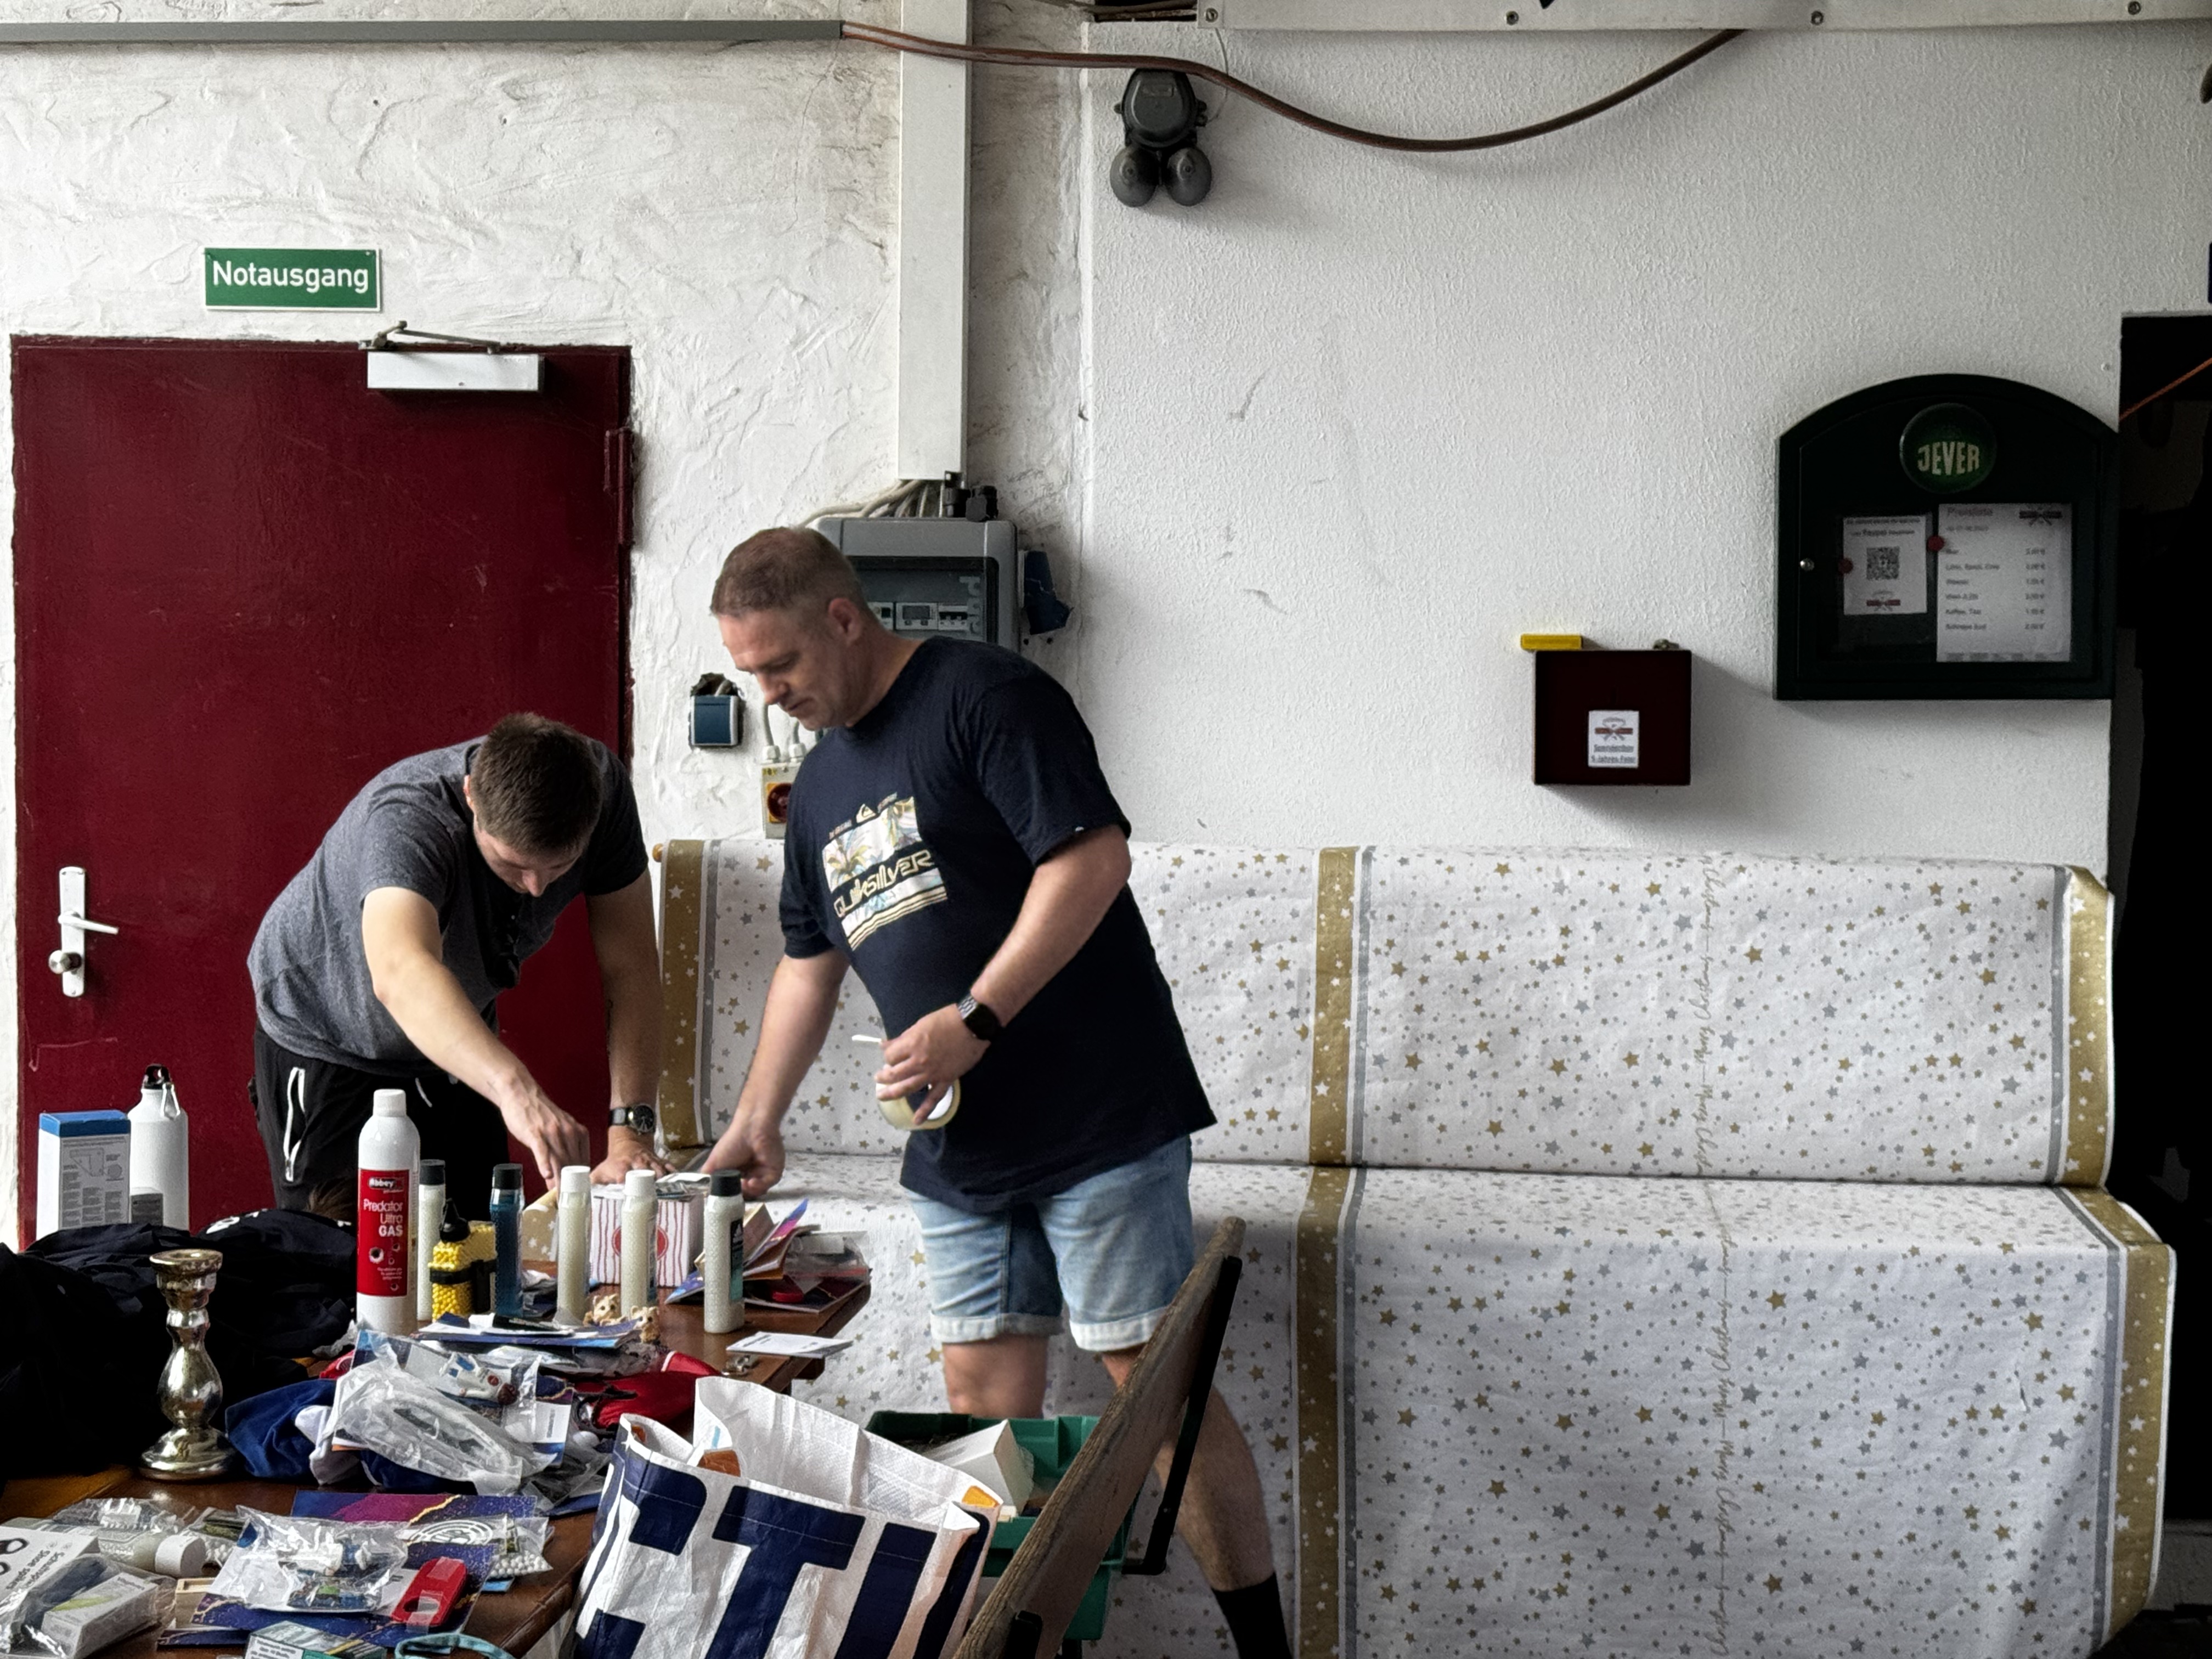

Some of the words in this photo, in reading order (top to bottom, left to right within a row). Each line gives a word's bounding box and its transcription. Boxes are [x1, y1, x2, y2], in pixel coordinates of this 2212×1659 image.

[213, 260, 369, 294] Notausgang
[1917, 441, 1980, 476] JEVER
[368, 1177, 394, 1189] Abbey
[363, 1198, 404, 1213] Predator
[380, 1212, 404, 1225] Ultra
[378, 1225, 404, 1238] GAS
